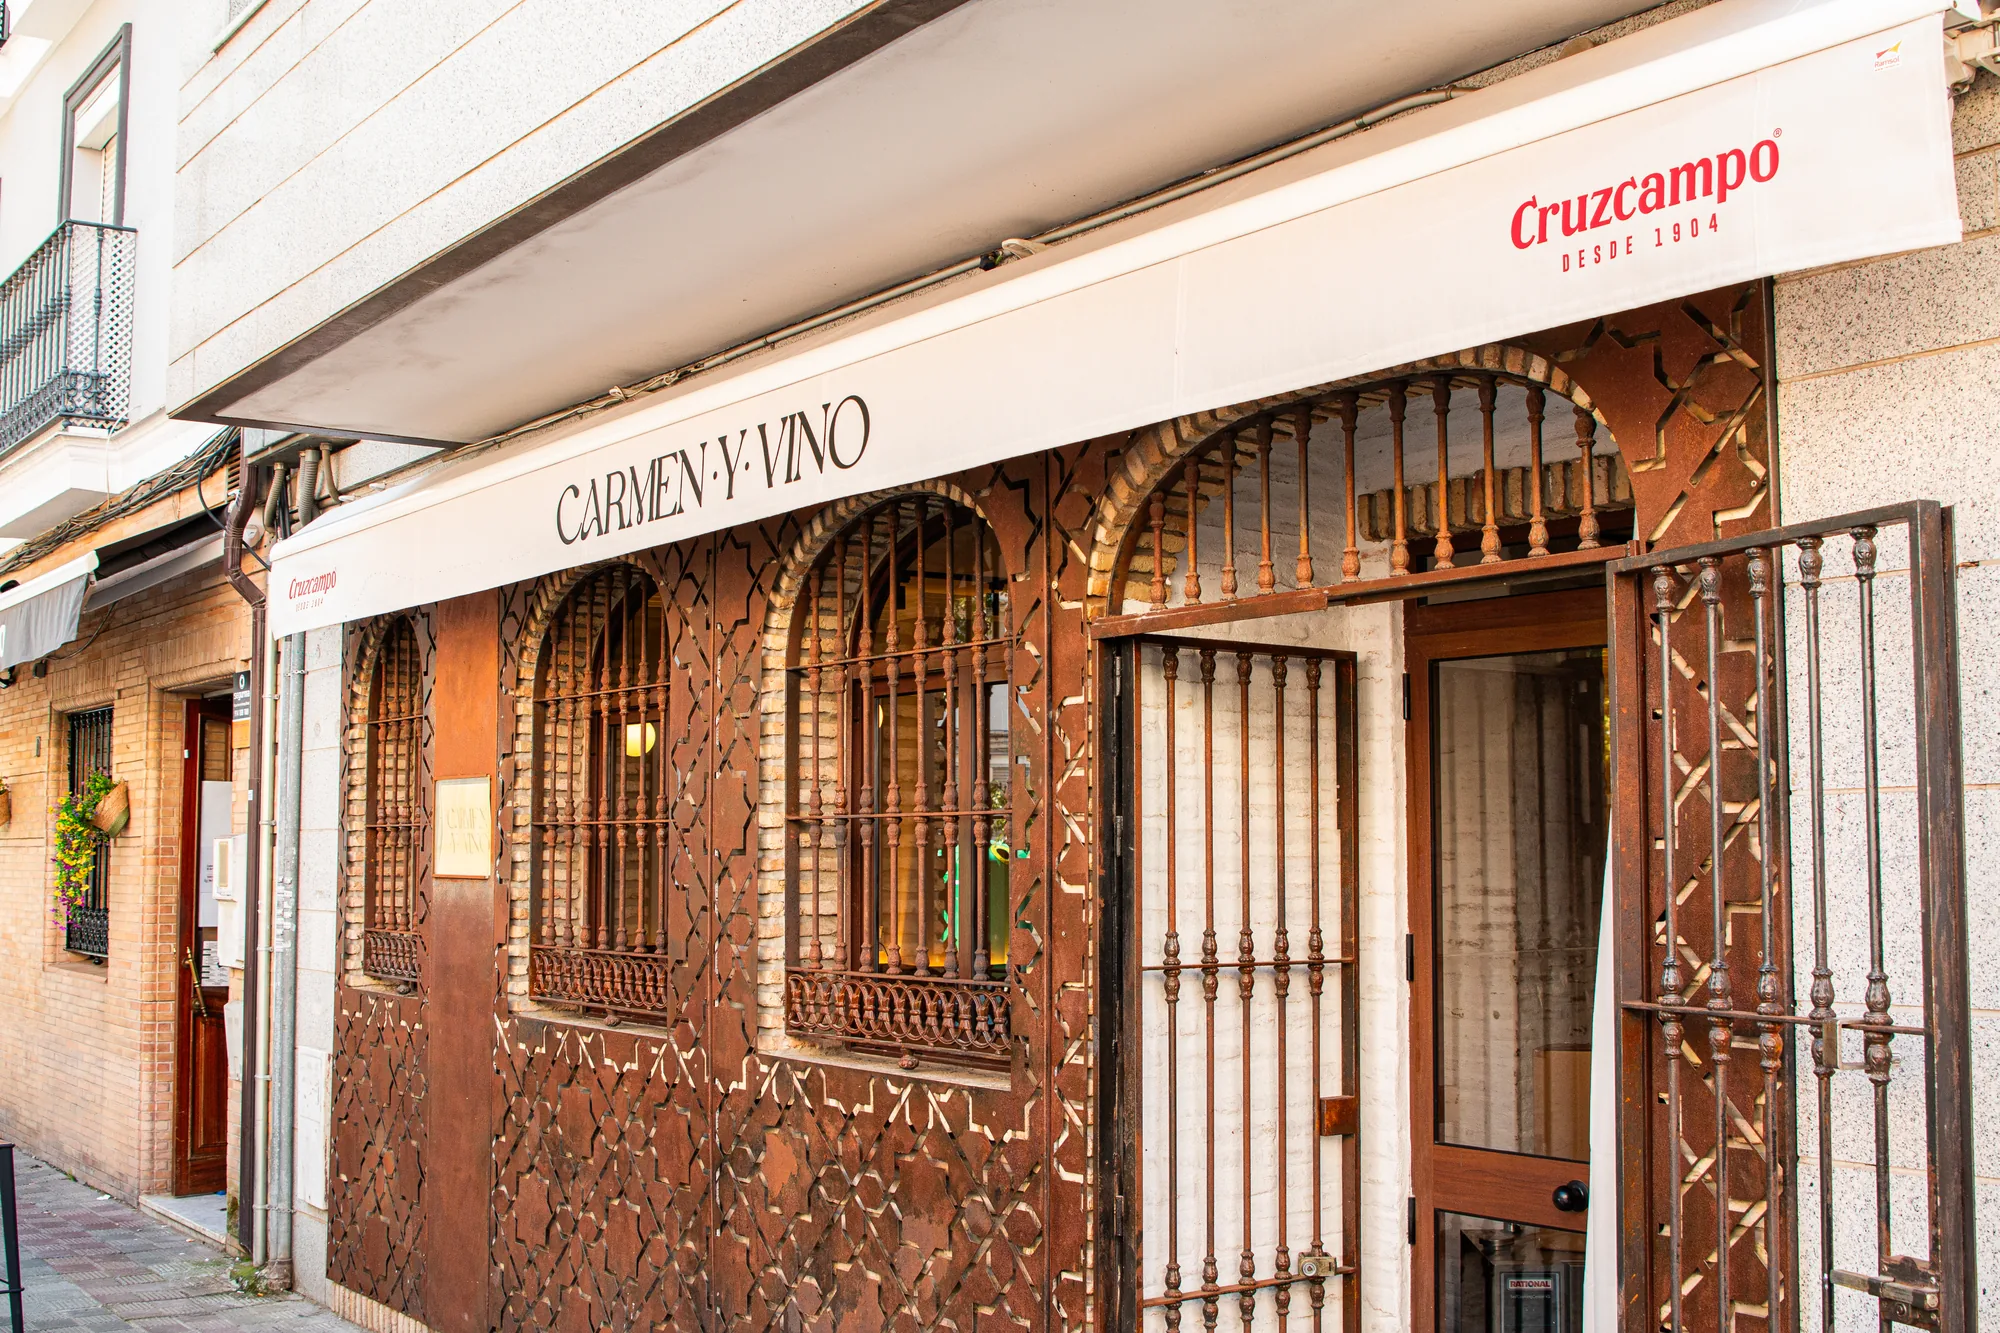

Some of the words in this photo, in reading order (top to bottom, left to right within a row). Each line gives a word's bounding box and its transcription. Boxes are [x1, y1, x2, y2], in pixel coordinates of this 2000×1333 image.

[1562, 236, 1633, 272] DESDE
[1655, 213, 1718, 247] 1904
[289, 570, 337, 600] Cruzcampo
[1510, 1280, 1551, 1288] RATIONAL
